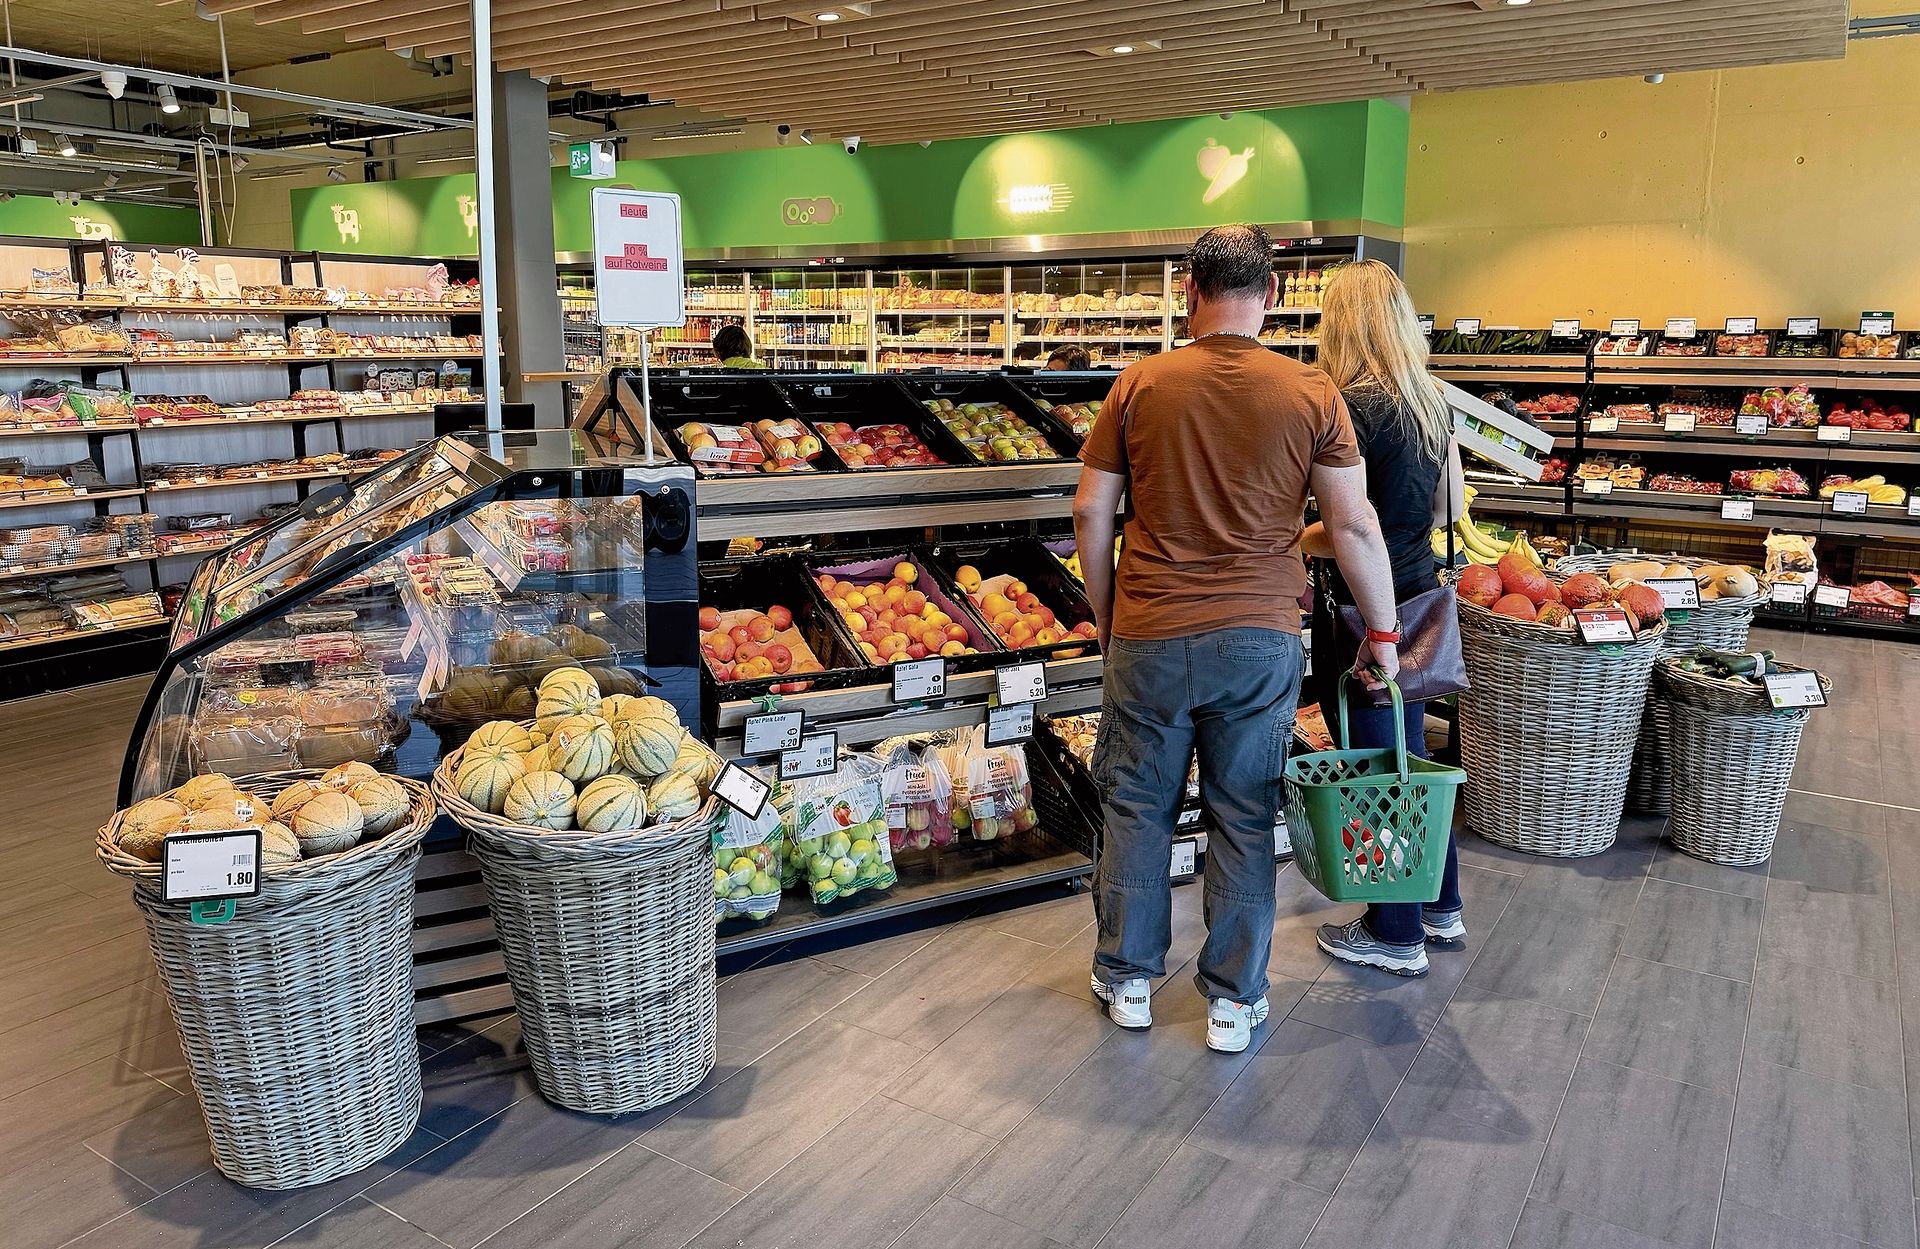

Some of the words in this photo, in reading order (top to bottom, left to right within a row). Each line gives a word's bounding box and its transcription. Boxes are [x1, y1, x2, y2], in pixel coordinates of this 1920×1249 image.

[621, 204, 648, 217] Heute
[625, 245, 636, 255] 10
[638, 246, 648, 256] %
[607, 259, 622, 268] auf
[625, 258, 668, 270] Rotweine
[926, 684, 942, 695] 2.80
[1029, 687, 1044, 697] 5.20
[1804, 694, 1822, 703] 3.30
[1017, 723, 1032, 734] 3.95
[780, 737, 798, 748] 5.20
[815, 757, 832, 768] 3.95
[226, 871, 253, 886] 1.80
[1124, 995, 1147, 1005] PUMA
[1211, 1017, 1235, 1029] PUMA
